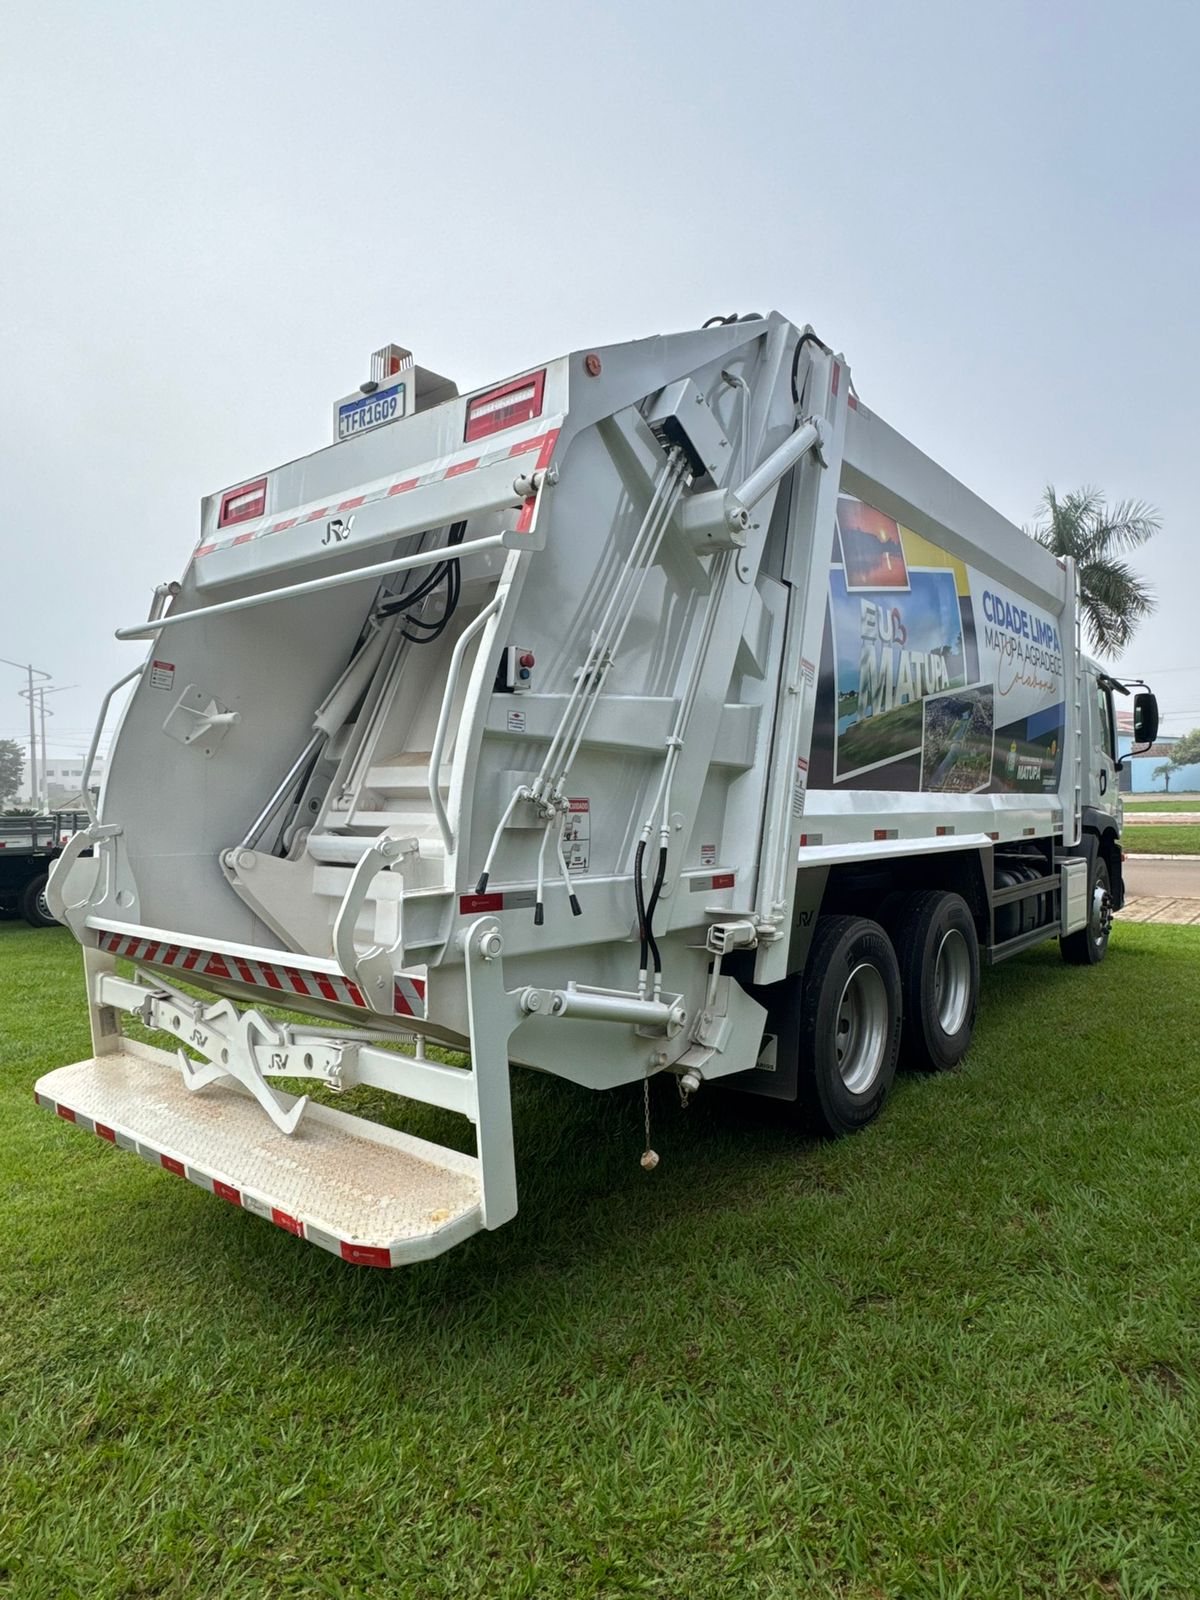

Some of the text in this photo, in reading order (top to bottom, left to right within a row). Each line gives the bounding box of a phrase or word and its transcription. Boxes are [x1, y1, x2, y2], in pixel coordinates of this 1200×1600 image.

[344, 396, 398, 433] TFR1G09
[860, 597, 893, 642] EU
[982, 589, 1060, 653] CIDADE LIMPA
[984, 625, 1062, 677] MATUPÁ AGRADECE
